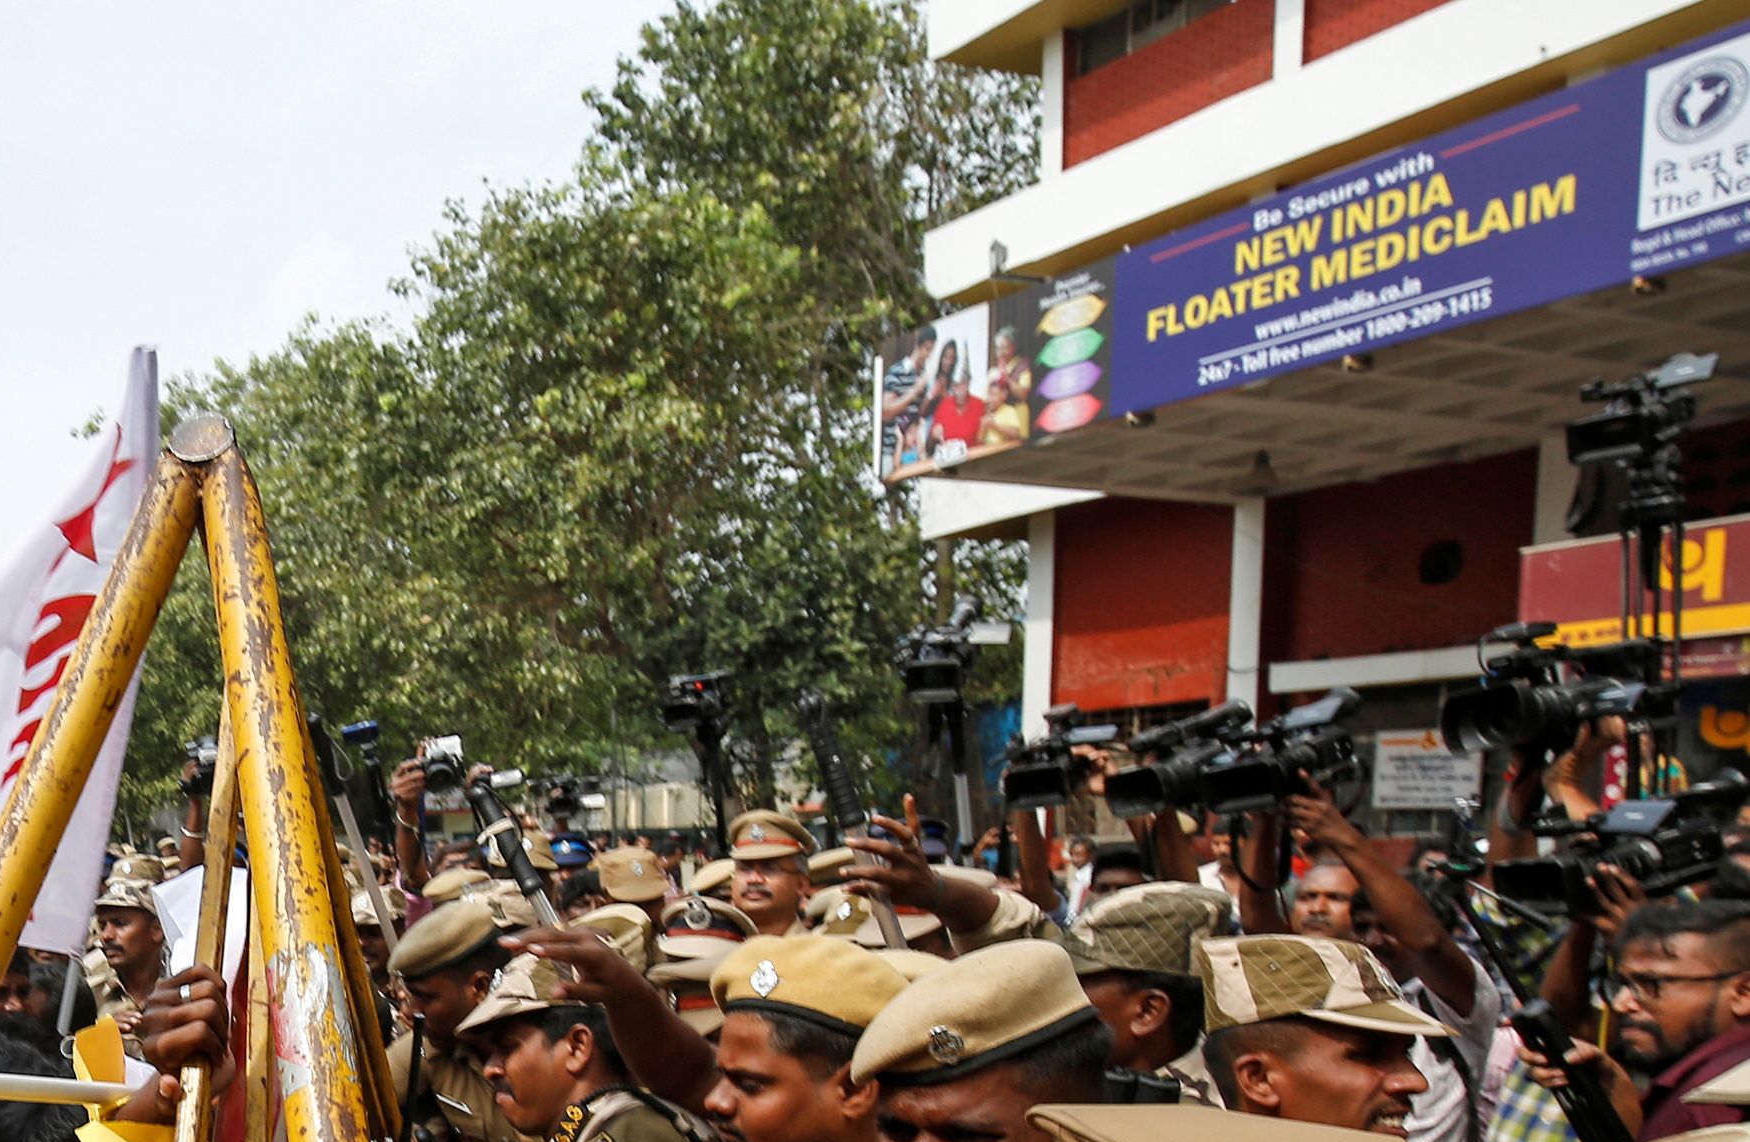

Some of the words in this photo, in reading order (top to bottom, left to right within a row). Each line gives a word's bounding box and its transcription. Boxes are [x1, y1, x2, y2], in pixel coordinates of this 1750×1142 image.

[1234, 214, 1324, 275] NEW
[1331, 172, 1454, 244] INDIA
[1253, 208, 1284, 232] Be
[1287, 177, 1371, 219] Secure
[1373, 151, 1435, 188] with
[1651, 188, 1701, 216] The
[1146, 267, 1301, 343] FLOATER
[1310, 174, 1577, 292] MEDICLAIM
[1198, 361, 1232, 386] 24x7
[1241, 350, 1268, 375] Toll
[1268, 343, 1300, 367] free
[1301, 325, 1365, 357] number
[1366, 287, 1492, 341] 1800-209-1415
[1254, 276, 1423, 340] www.newindia.co.in
